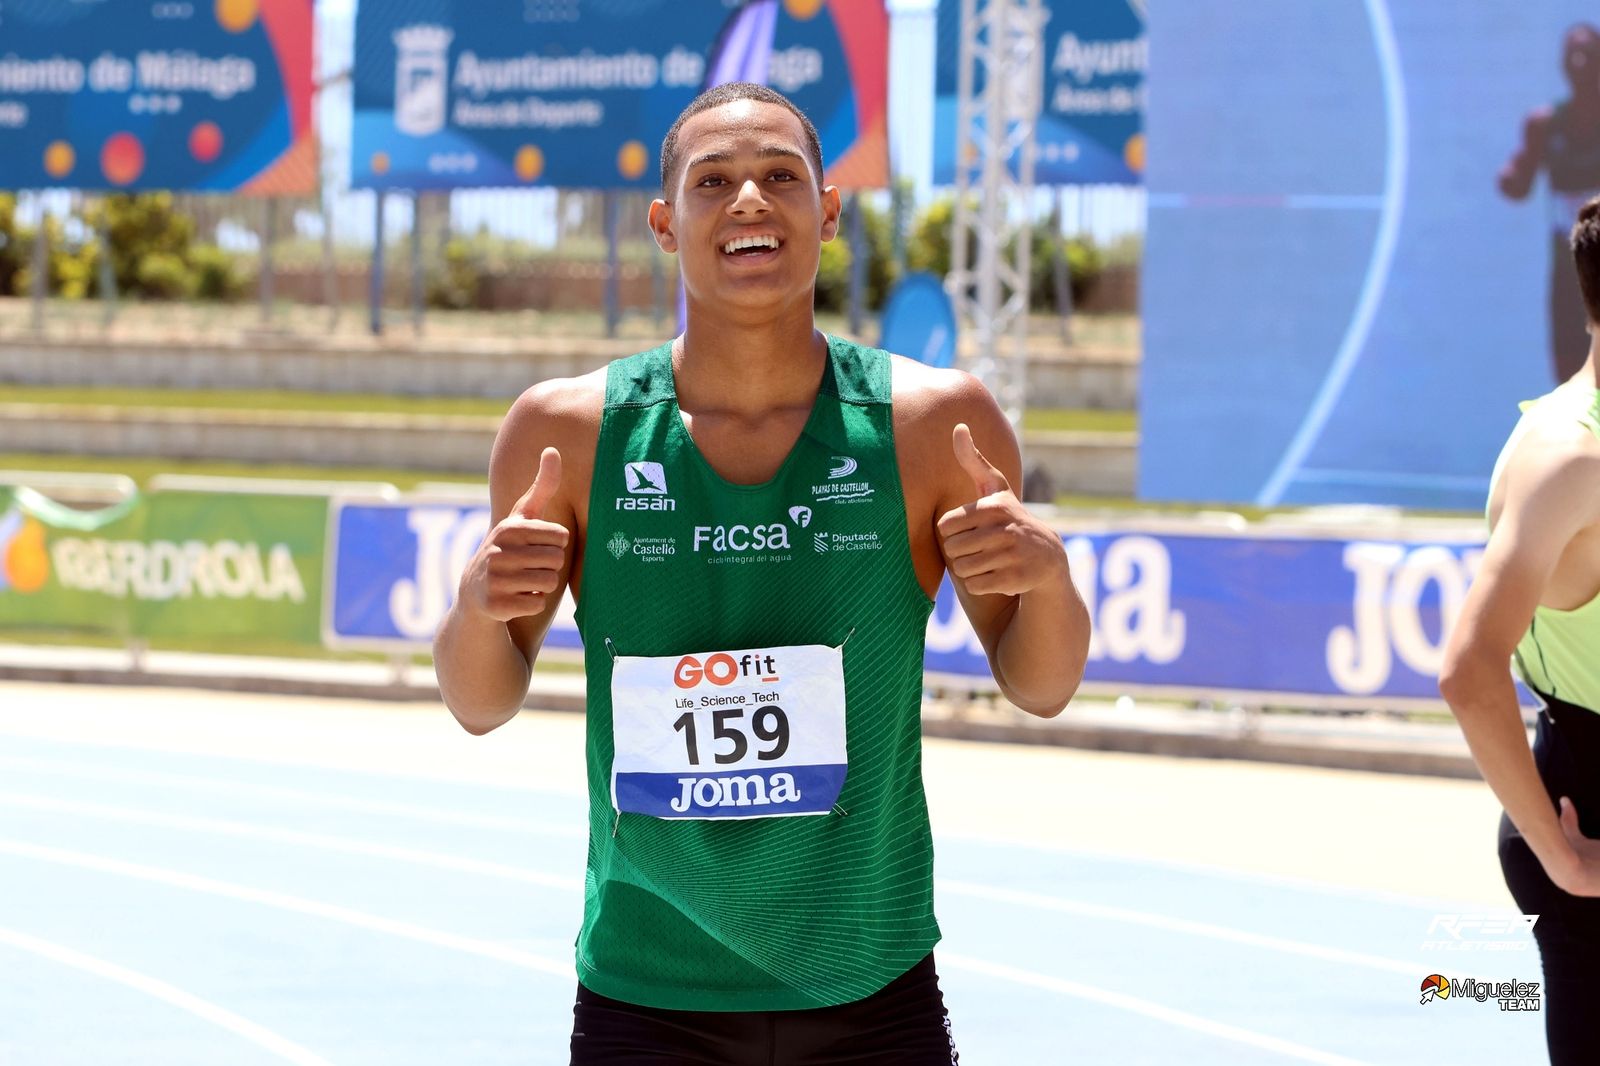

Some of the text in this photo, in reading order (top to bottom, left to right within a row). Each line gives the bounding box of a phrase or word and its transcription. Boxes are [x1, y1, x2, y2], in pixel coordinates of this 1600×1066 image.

[88, 51, 134, 93] de
[454, 50, 656, 98] Ayuntamiento
[662, 47, 704, 87] de
[811, 484, 831, 495] PLAYAS
[831, 483, 839, 493] DE
[615, 495, 676, 511] rasán
[832, 531, 878, 543] Diputació
[633, 543, 675, 555] Castelló
[832, 541, 883, 551] de Castelló
[642, 555, 665, 563] Esports
[769, 554, 792, 563] agua
[53, 537, 306, 603] IBERDROLA
[673, 705, 790, 766] 159
